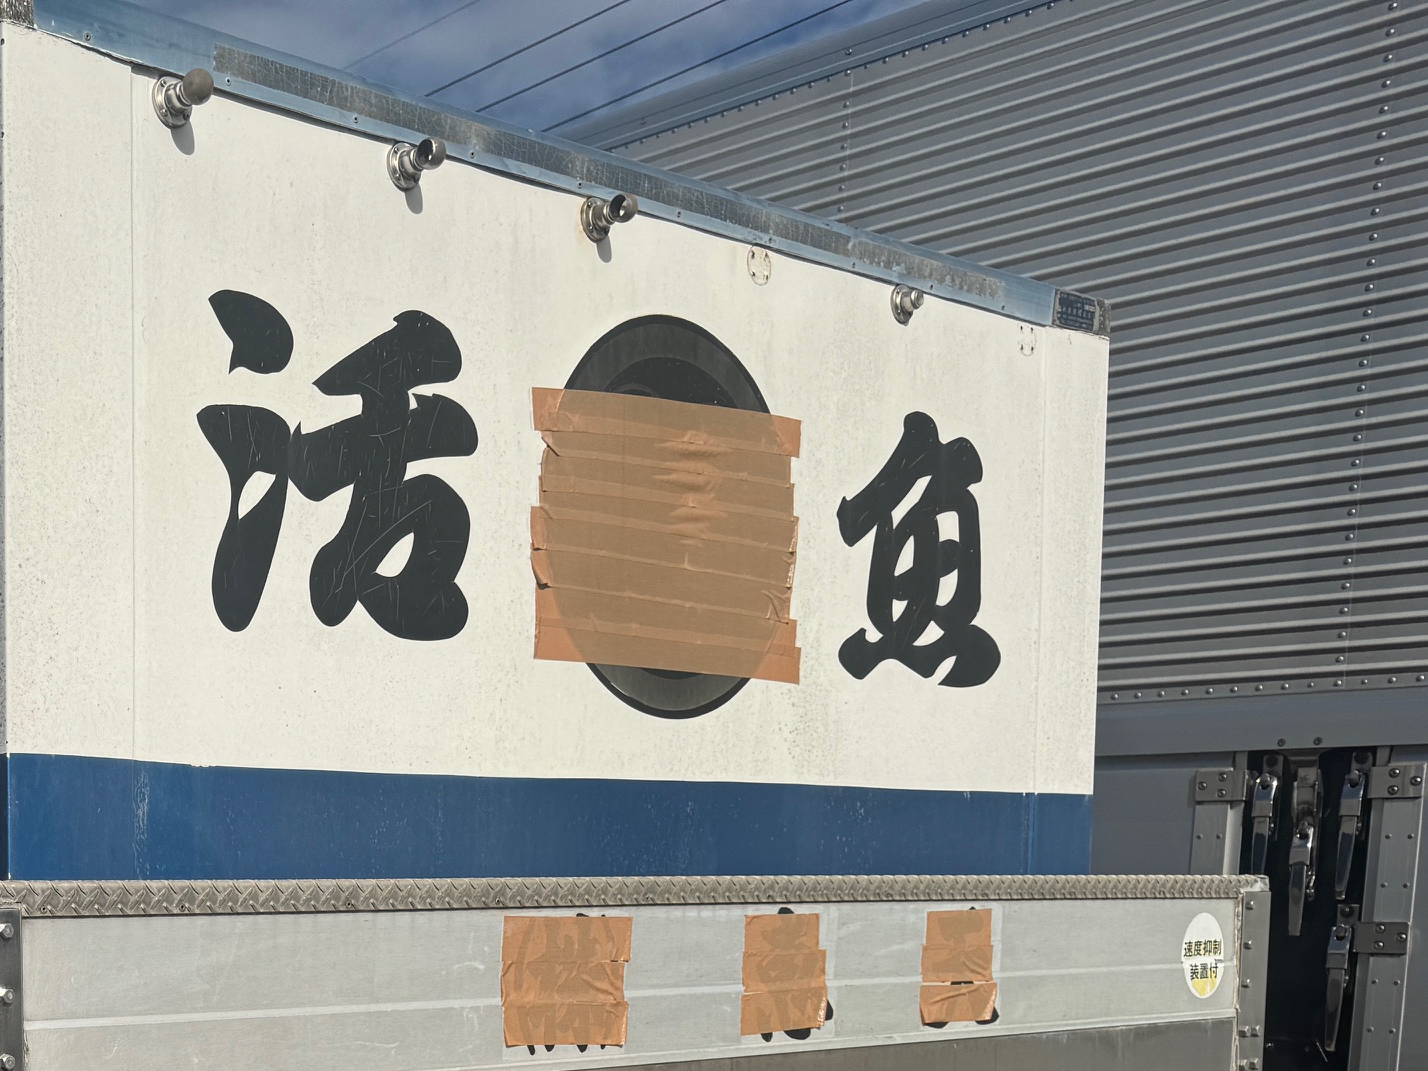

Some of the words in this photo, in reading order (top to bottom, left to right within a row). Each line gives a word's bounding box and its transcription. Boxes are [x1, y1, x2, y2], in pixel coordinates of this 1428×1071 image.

[197, 290, 478, 641] 活
[837, 411, 1000, 687] 魚
[1184, 940, 1222, 957] 速度抑制
[1190, 963, 1218, 980] 装置付
